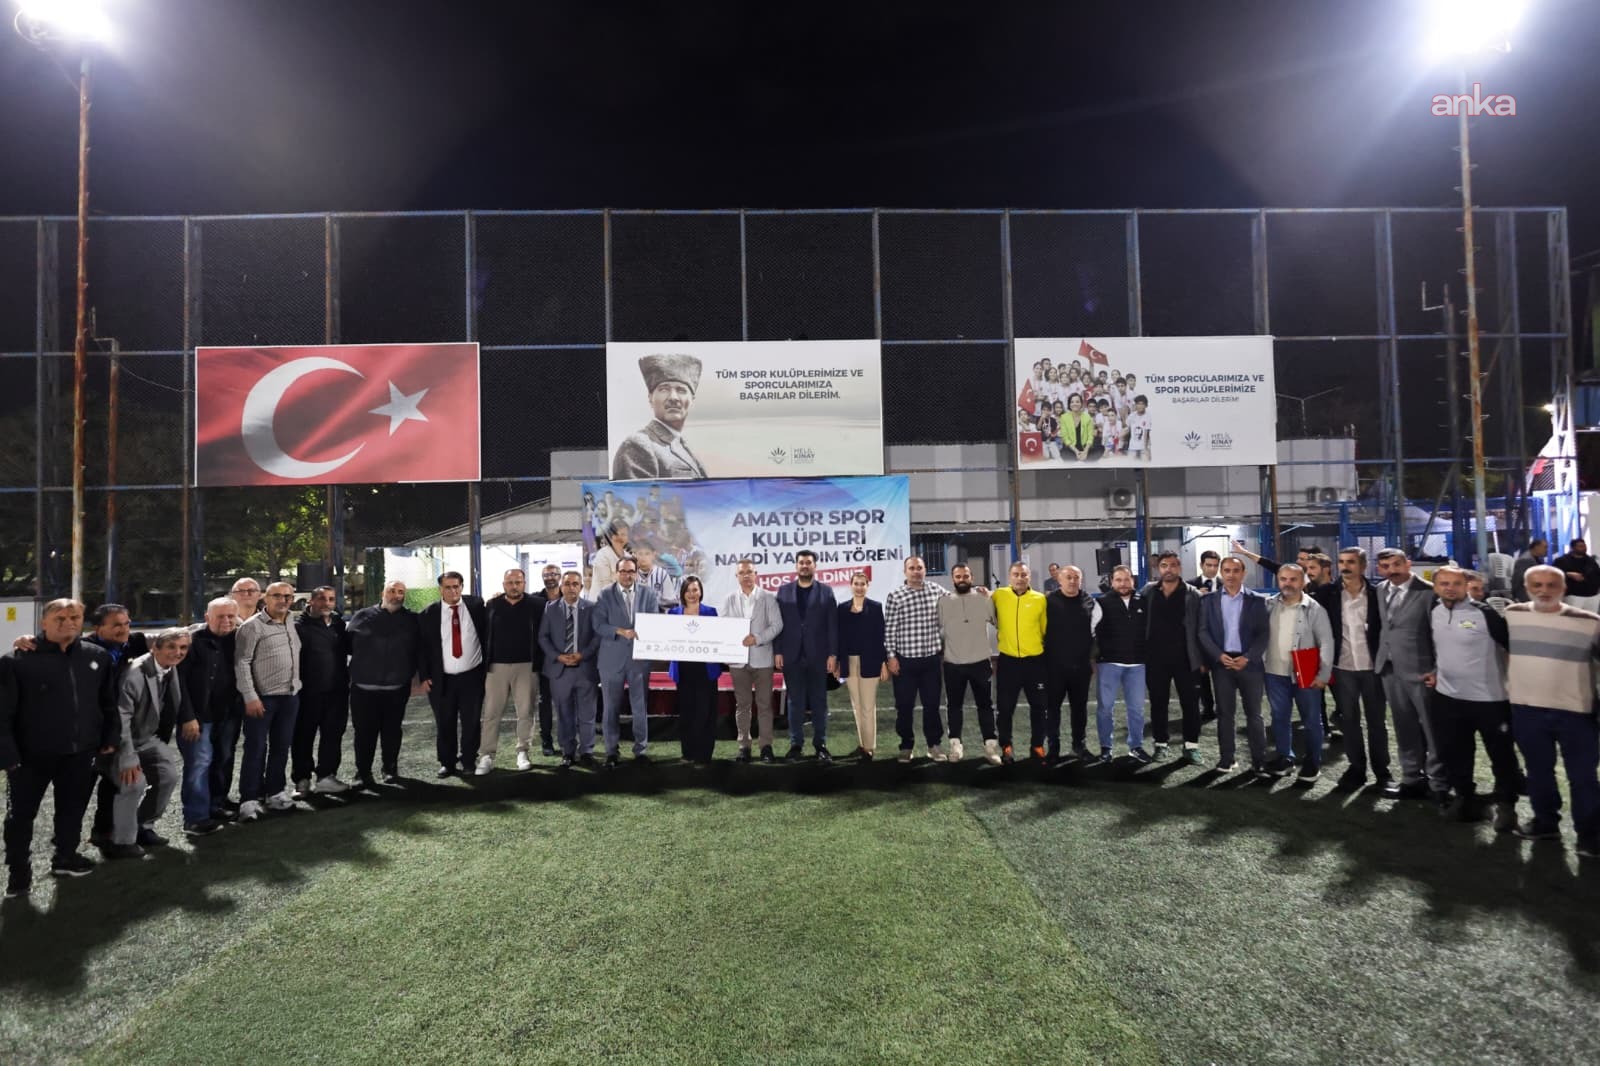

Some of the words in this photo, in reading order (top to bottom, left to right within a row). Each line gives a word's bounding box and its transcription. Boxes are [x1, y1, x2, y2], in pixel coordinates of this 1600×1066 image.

[715, 369, 738, 379] TÜM
[740, 370, 767, 379] SPOR
[769, 368, 848, 378] KULÜPLERİMİZE
[850, 369, 864, 377] VE
[1145, 373, 1165, 383] TÜM
[1168, 375, 1250, 383] SPORCULARIMIZA
[1252, 374, 1265, 382] VE
[744, 380, 833, 389] SPORCULARIMIZA
[1155, 386, 1180, 394] SPOR
[1183, 383, 1256, 393] KULÜPLERİMİZE
[739, 391, 796, 402] BAŞARILAR
[732, 506, 823, 527] AMATÖR
[829, 509, 885, 525] SPOR
[752, 525, 866, 547] KULÜPLERİ
[845, 545, 903, 562] TÖRENİ
